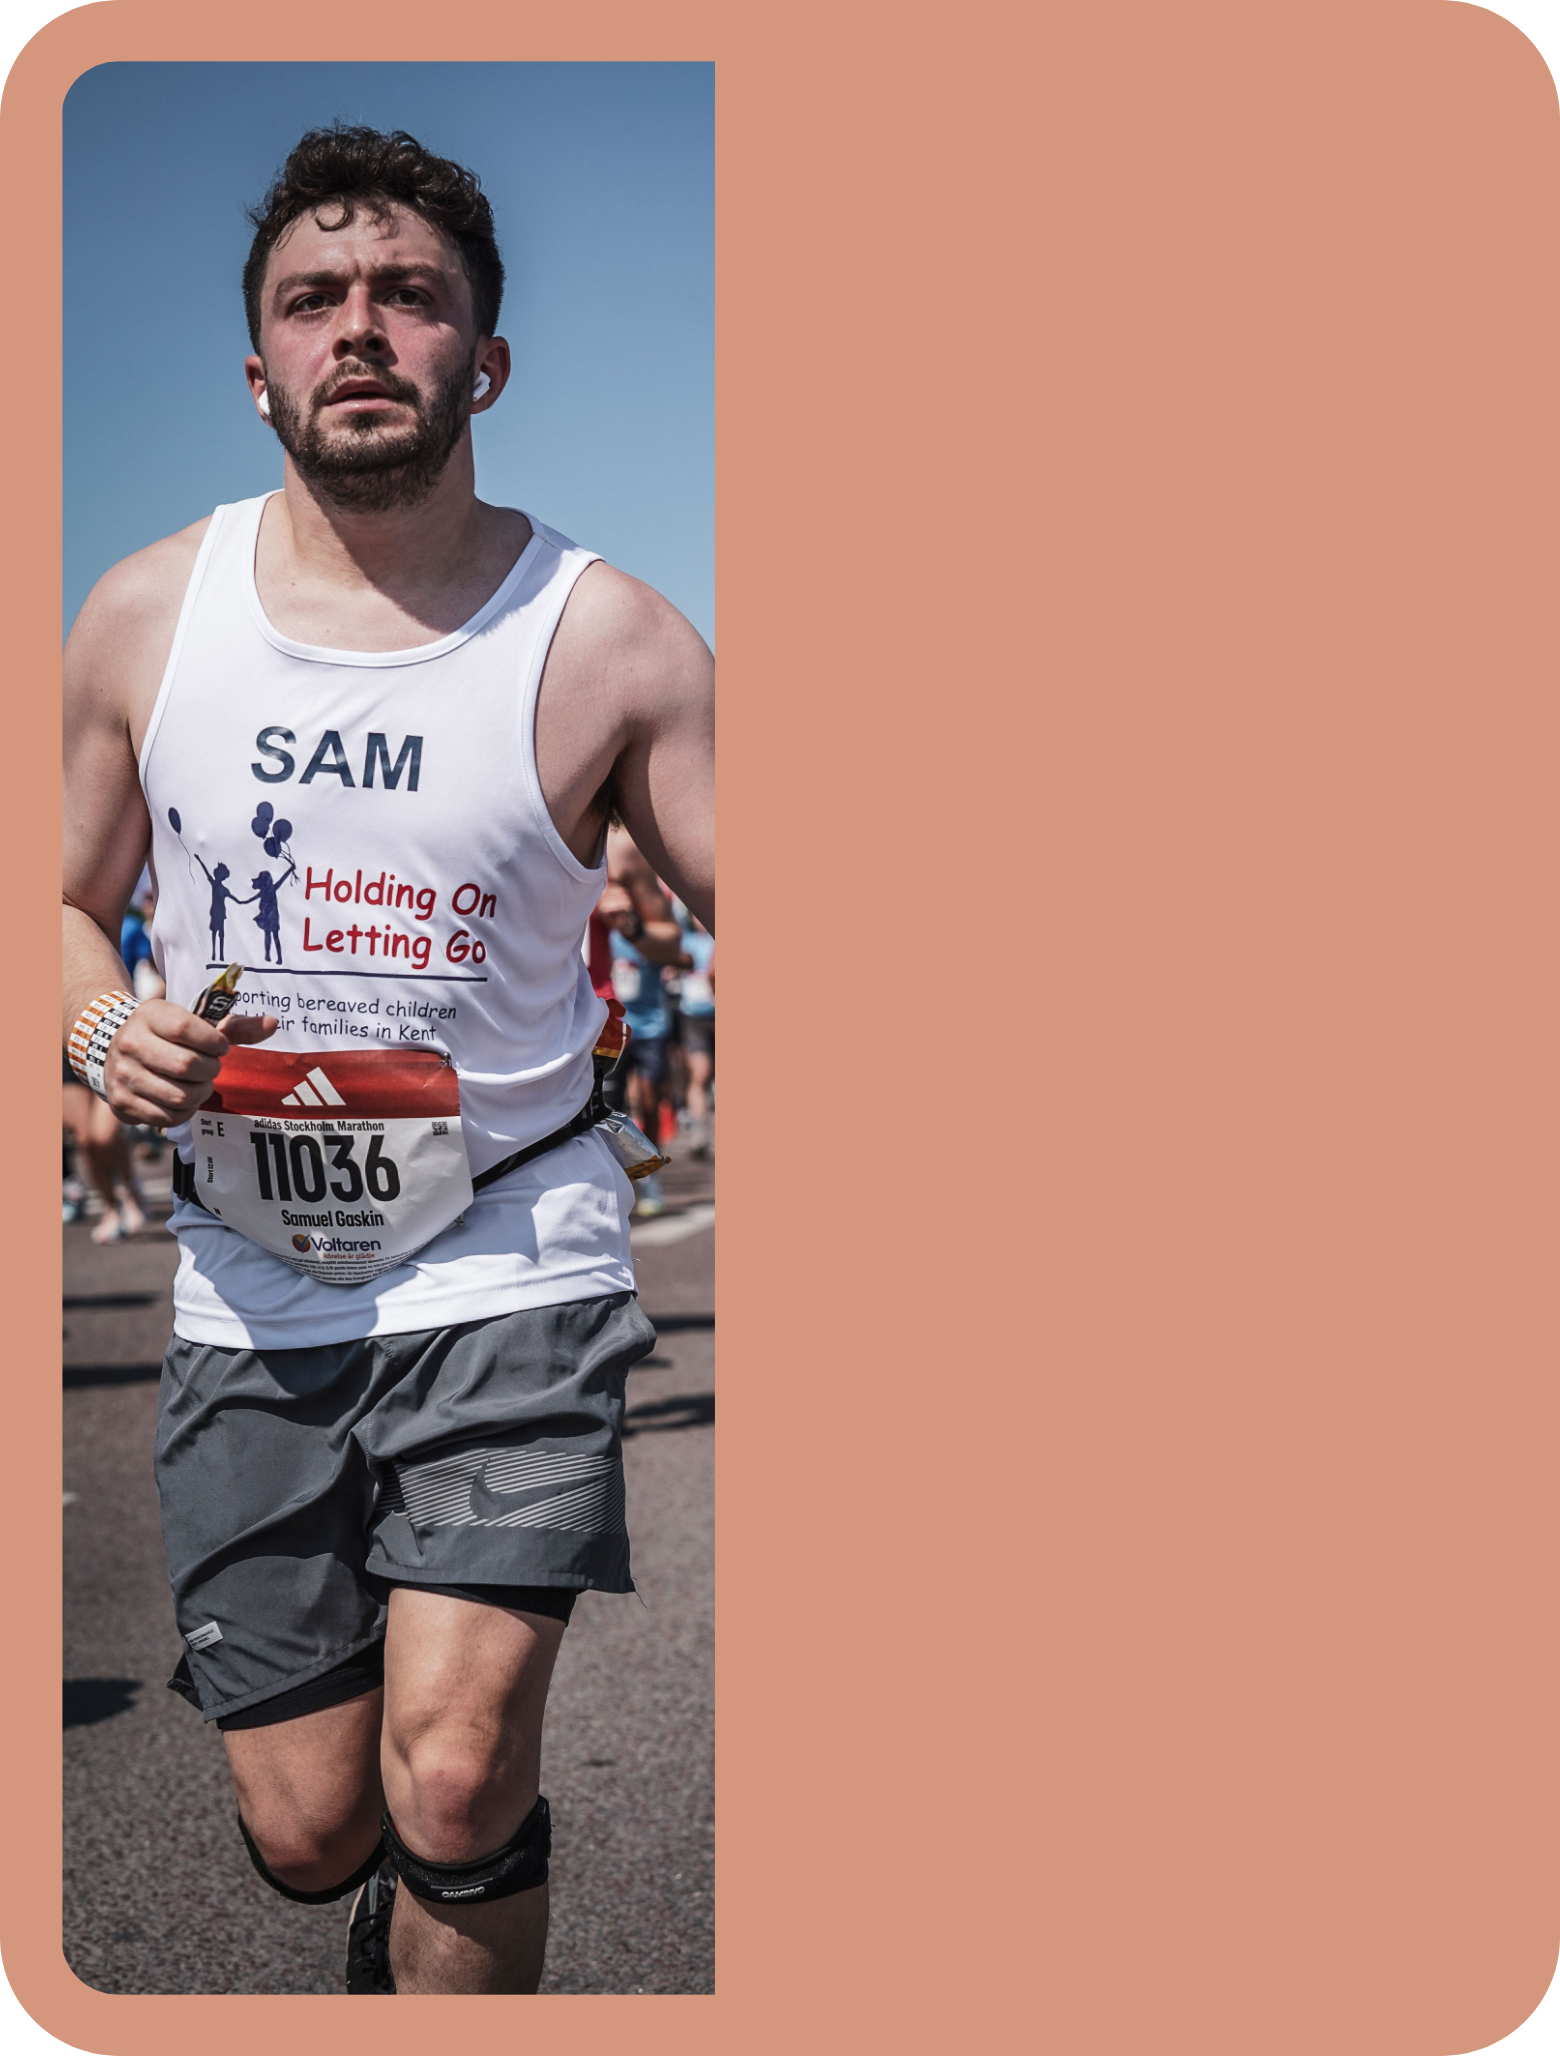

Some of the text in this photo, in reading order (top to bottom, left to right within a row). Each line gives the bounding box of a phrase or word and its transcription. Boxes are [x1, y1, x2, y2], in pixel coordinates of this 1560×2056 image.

[251, 725, 424, 792] SAM
[305, 866, 498, 921] Holding On
[303, 917, 487, 970] Letting Go
[234, 990, 457, 1020] porting bereaved children
[301, 1015, 369, 1038] families
[376, 1021, 392, 1039] in
[398, 1022, 437, 1042] Kent
[216, 1121, 225, 1137] E
[254, 1119, 385, 1132] adidas Stockholm Marathon
[249, 1131, 401, 1203] 11036
[281, 1209, 385, 1228] Samuel Gaskin
[311, 1237, 381, 1251] Voltaren
